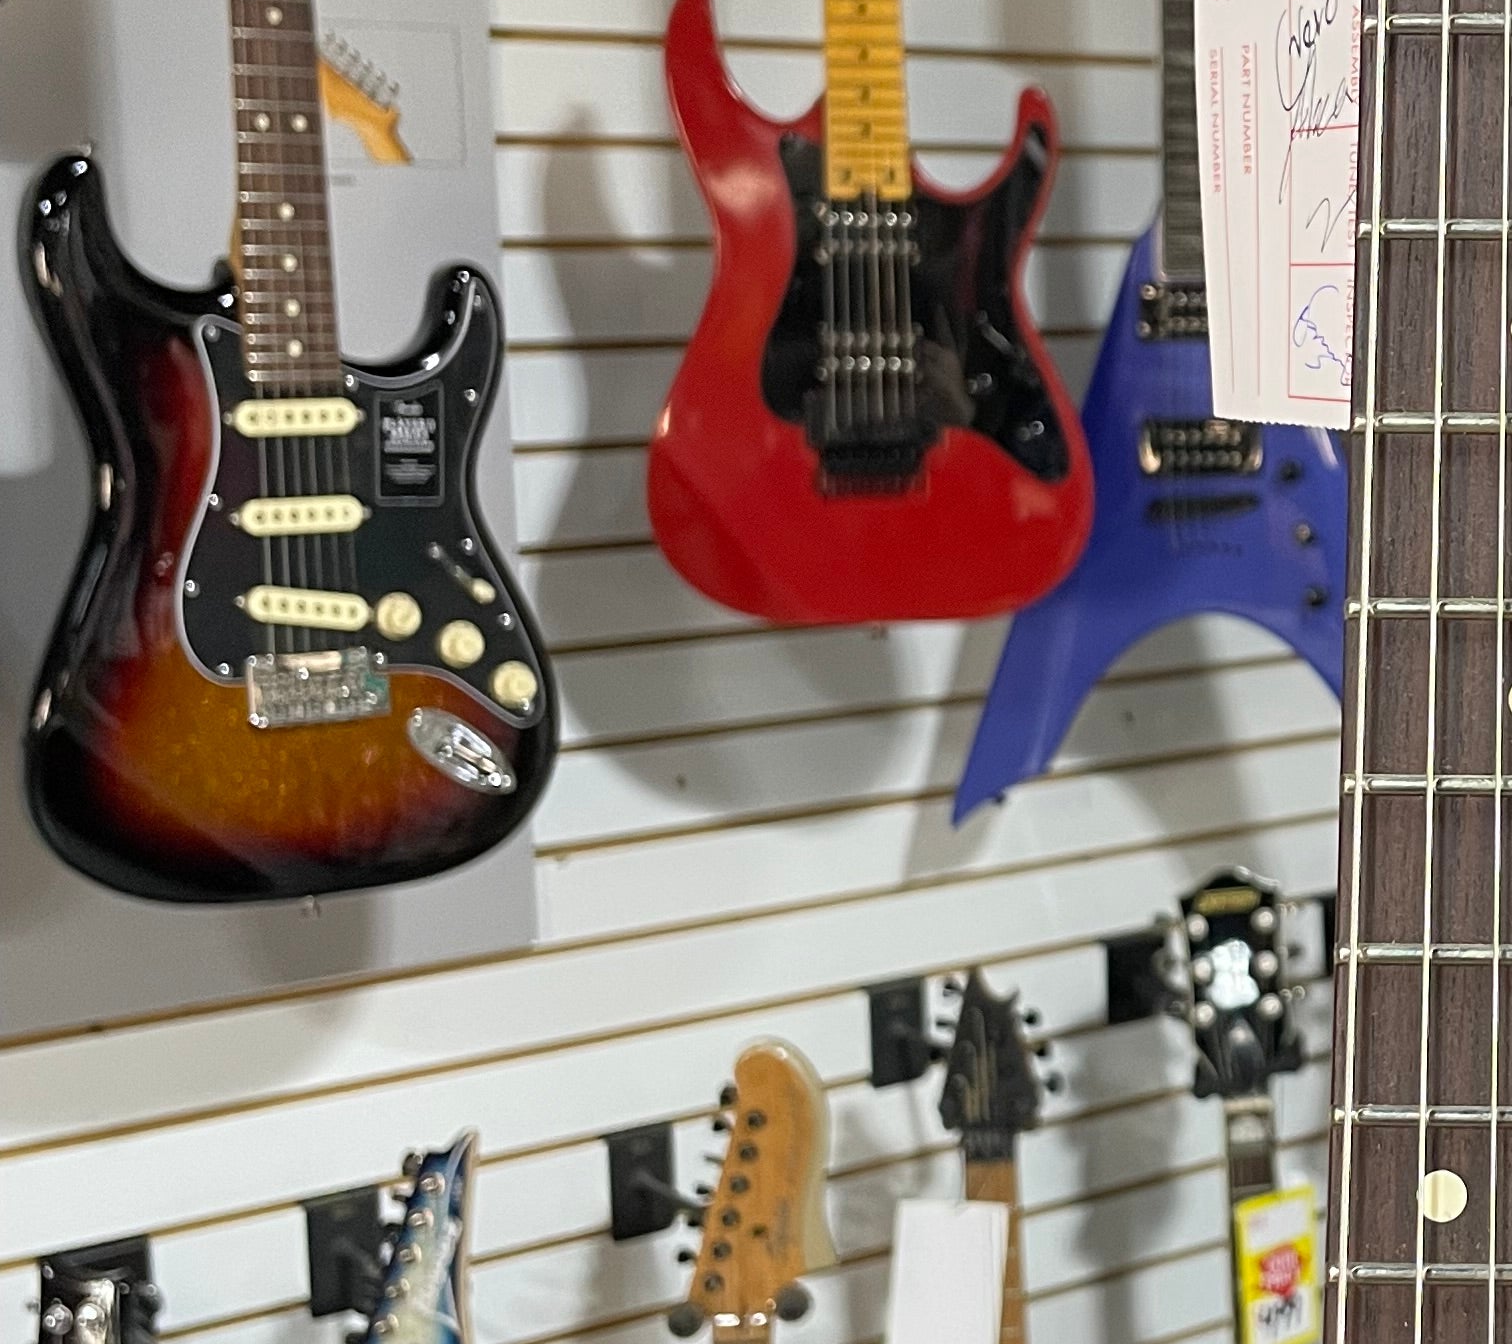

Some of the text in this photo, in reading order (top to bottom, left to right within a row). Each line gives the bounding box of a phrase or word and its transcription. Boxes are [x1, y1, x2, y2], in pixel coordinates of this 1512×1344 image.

[1209, 48, 1222, 194] SERIAL NUMBER
[1241, 44, 1253, 176] PART NUMBER
